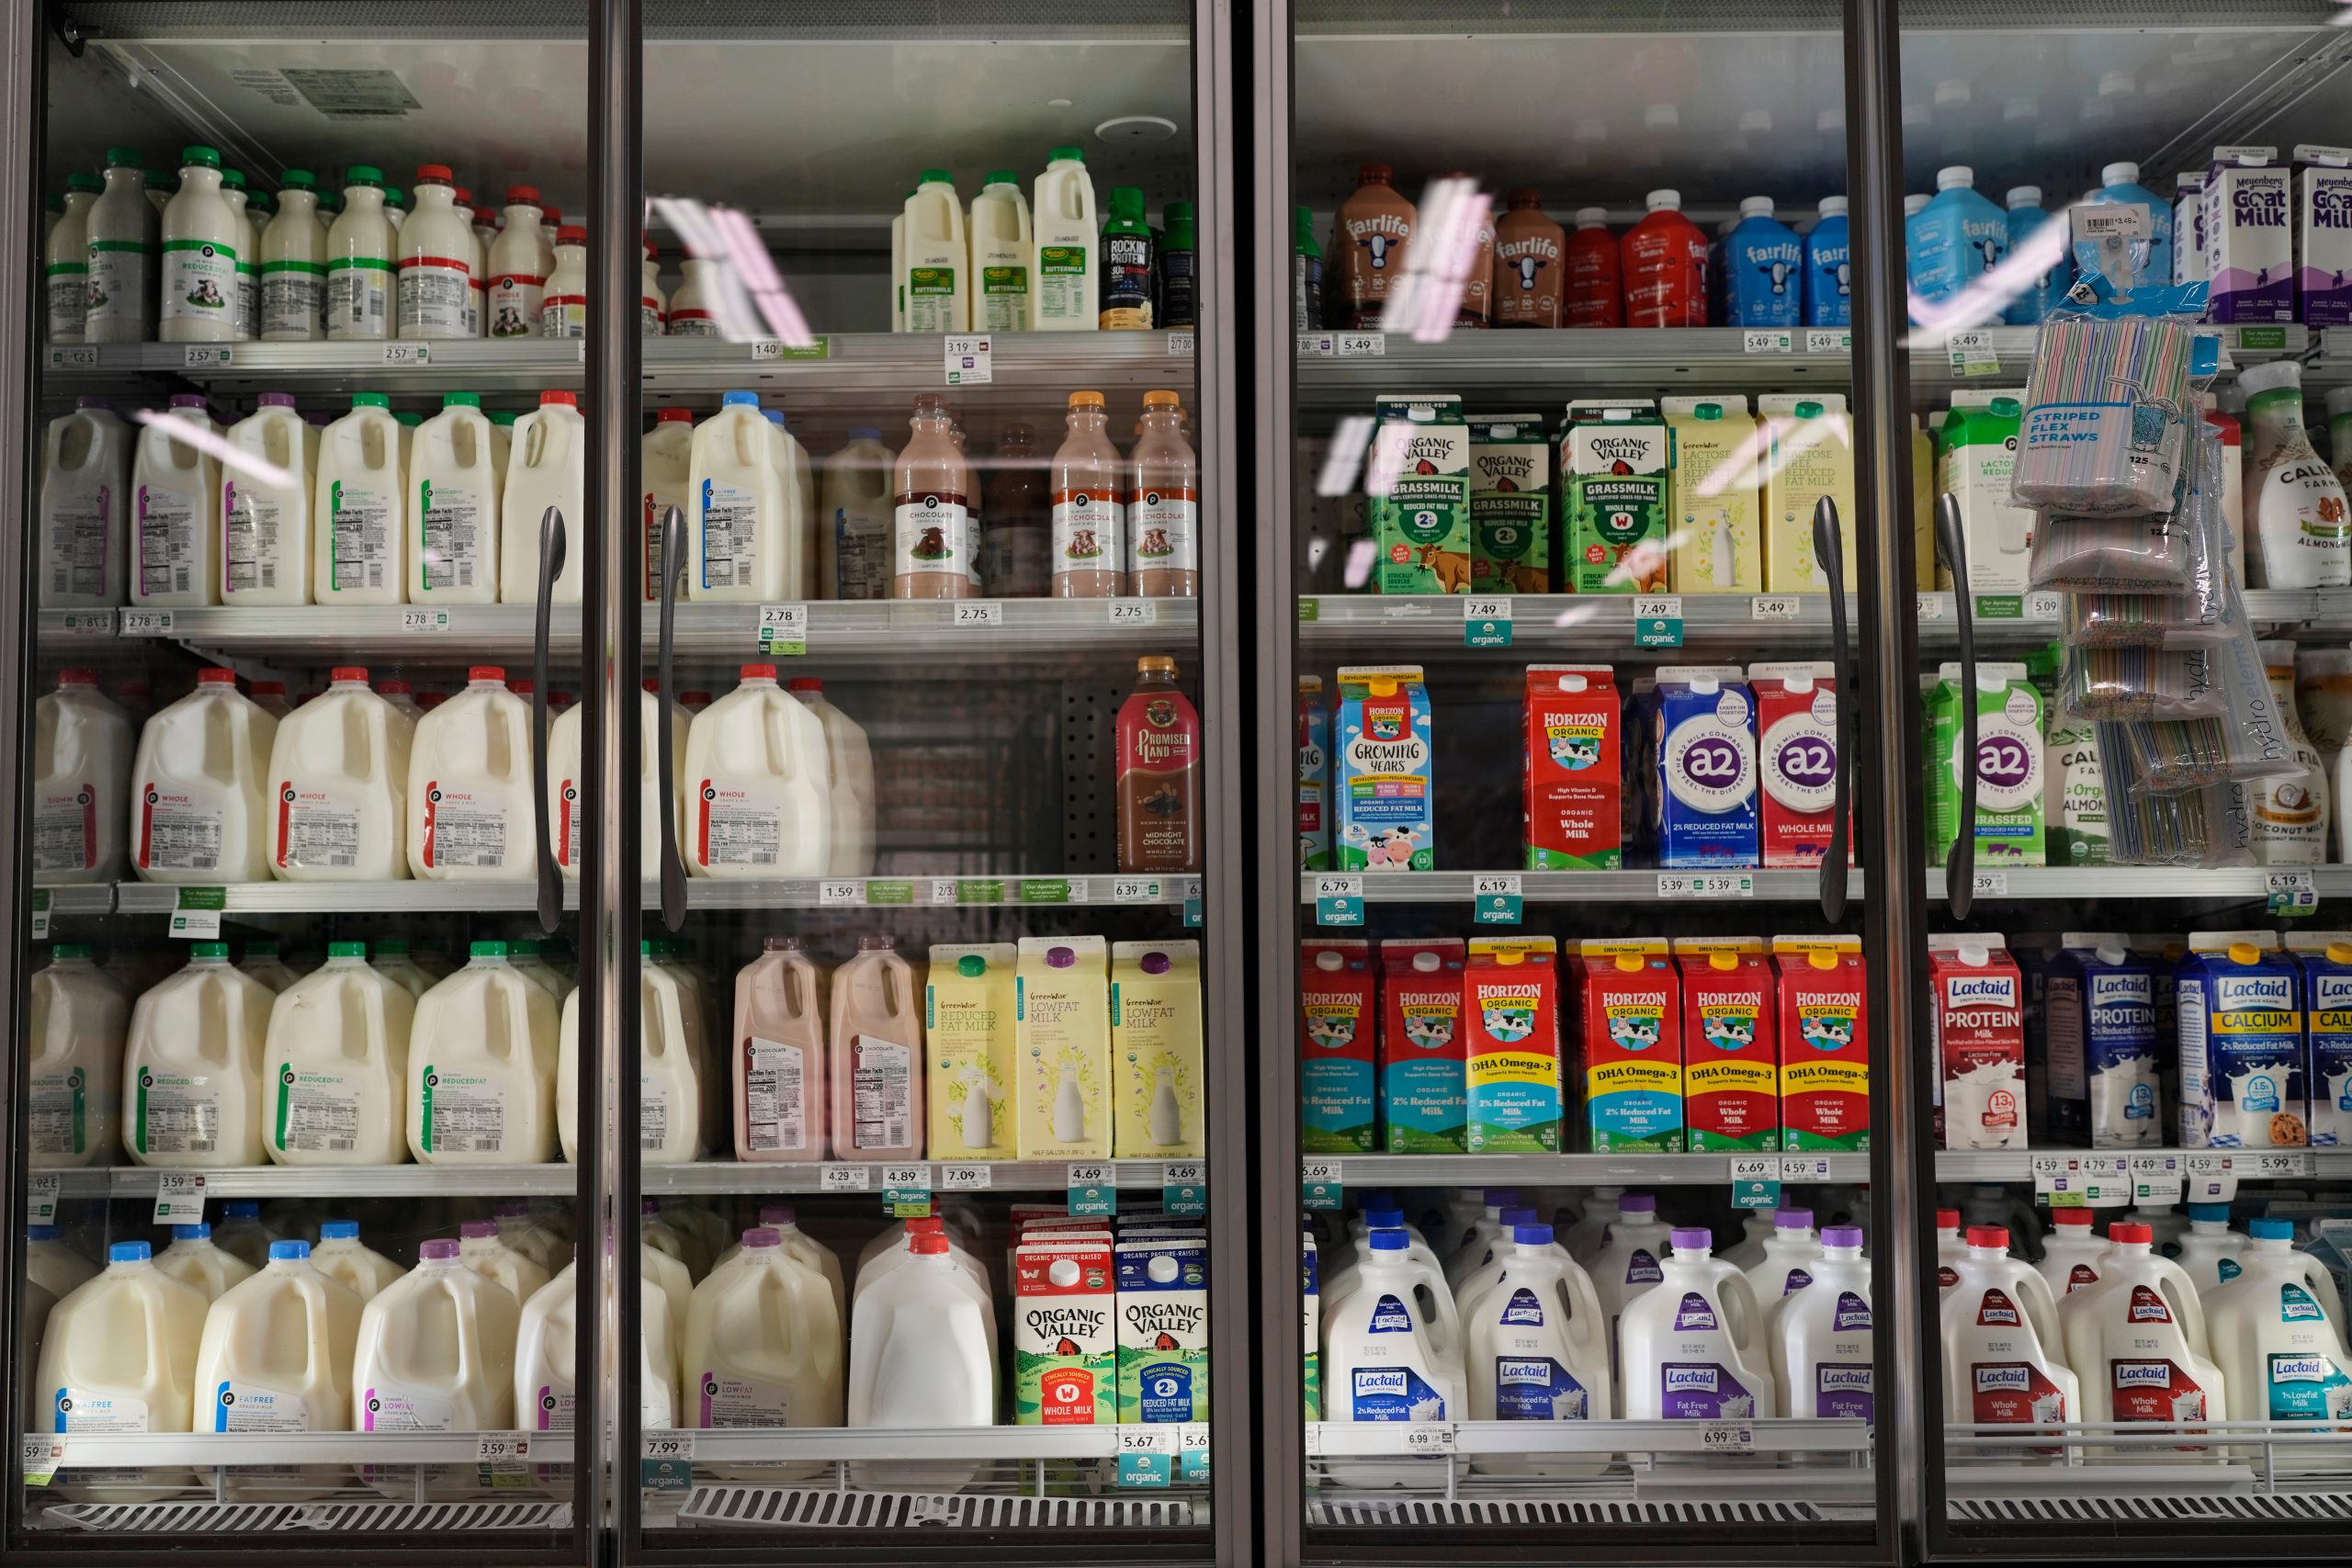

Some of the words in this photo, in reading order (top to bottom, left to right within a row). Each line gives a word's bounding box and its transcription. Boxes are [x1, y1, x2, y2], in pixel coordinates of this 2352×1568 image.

[2236, 175, 2285, 191] Meyenberg
[2232, 189, 2287, 209] Goat
[2234, 208, 2287, 228] Milk
[1111, 253, 1146, 265] PROTEIN
[1045, 265, 1084, 274] BUTTERMILK
[1344, 340, 1372, 350] 5.49
[2032, 412, 2101, 423] STRIPED
[2030, 423, 2070, 434] FLEX
[1590, 437, 1651, 452] ORGANIC
[2029, 433, 2099, 445] STRAWS
[1597, 447, 1645, 461] VALLEY
[1477, 456, 1535, 469] ORGANIC
[2130, 456, 2149, 465] 125
[1483, 465, 1531, 479] VALLEY
[1390, 481, 1463, 495] GRASSMILK
[1586, 482, 1658, 496] GRASSMILK
[1473, 499, 1542, 512] GRASSMILK
[960, 609, 989, 620] 2.75
[1114, 606, 1142, 617] 2.75
[1469, 604, 1497, 615] 7.49
[1639, 604, 1667, 615] 7.49
[1758, 603, 1785, 614] 5.49
[765, 611, 793, 622] 2.78
[1472, 634, 1505, 645] organic
[1642, 633, 1676, 644] organic
[1543, 712, 1609, 728] HORIZON
[1553, 728, 1600, 738] ORGANIC
[1136, 728, 1191, 756] PROMISED
[1143, 743, 1170, 764] LAND
[1354, 742, 1420, 761] GROWING
[1690, 747, 1736, 777] a2
[1784, 745, 1832, 775] a2
[1979, 746, 2025, 776] a2
[1370, 760, 1407, 773] YEARS
[162, 795, 188, 803] WHOLE
[299, 793, 326, 801] WHOLE
[445, 793, 472, 801] WHOLE
[719, 791, 746, 799] WHOLE
[1353, 806, 1389, 814] REDUCED
[1390, 805, 1404, 813] FAT
[1404, 804, 1423, 813] MILK
[1559, 819, 1595, 829] Whole
[1683, 823, 1720, 832] REDUCED
[1720, 823, 1736, 831] FAT
[1735, 822, 1755, 831] MILK
[1145, 831, 1182, 840] MIDNIGHT
[1565, 829, 1590, 840] Milk
[826, 886, 854, 898] 1.59
[1320, 881, 1350, 892] 6.79
[1478, 881, 1508, 892] 6.19
[1324, 911, 1358, 923] organic
[1482, 909, 1516, 921] organic
[1476, 983, 1542, 999] HORIZON
[1951, 979, 2012, 998] Lactaid
[2097, 976, 2148, 995] Lactaid
[2222, 979, 2289, 998] Lactaid
[1399, 992, 1462, 1006] HORIZON
[1486, 999, 1533, 1010] ORGANIC
[1602, 991, 1668, 1007] HORIZON
[1697, 991, 1763, 1007] HORIZON
[1795, 991, 1861, 1007] HORIZON
[1030, 1001, 1080, 1013] LOWFAT
[1125, 1007, 1175, 1019] LOWFAT
[1309, 1007, 1354, 1016] ORGANIC
[1408, 1007, 1453, 1016] ORGANIC
[1611, 1007, 1658, 1017] ORGANIC
[1706, 1007, 1753, 1017] ORGANIC
[1804, 1007, 1852, 1017] ORGANIC
[940, 1010, 997, 1021] REDUCED
[1030, 1011, 1062, 1023] MILK
[1945, 1011, 2020, 1029] PROTEIN
[2090, 1008, 2155, 1025] PROTEIN
[2222, 1012, 2293, 1029] CALCIUM
[940, 1021, 963, 1032] FAT
[964, 1021, 996, 1032] MILK
[1125, 1017, 1158, 1029] MILK
[1471, 1060, 1498, 1073] DHA
[1498, 1057, 1553, 1072] Omega-3
[1596, 1067, 1624, 1081] DHA
[1625, 1066, 1679, 1081] Omega-3
[1690, 1067, 1719, 1081] DHA
[1720, 1066, 1773, 1081] Omega-3
[1736, 1162, 1766, 1173] 6.69
[2261, 1158, 2290, 1169] 5.99
[828, 1171, 850, 1182] 4.29
[888, 1171, 916, 1182] 4.89
[947, 1170, 976, 1181] 7.09
[1072, 1168, 1102, 1179] 4.69
[1168, 1168, 1197, 1179] 4.69
[900, 1192, 927, 1201] organic
[1303, 1197, 1336, 1208] organic
[1740, 1194, 1774, 1206] organic
[1076, 1201, 1109, 1213] organic
[1170, 1201, 1204, 1213] organic
[1026, 1307, 1106, 1326] ORGANIC
[1125, 1303, 1204, 1323] ORGANIC
[1034, 1322, 1101, 1340] VALLEY
[1133, 1318, 1198, 1336] VALLEY
[1502, 1363, 1549, 1380] Lactaid
[2120, 1365, 2166, 1381] Lactaid
[2276, 1360, 2321, 1376] Lactaid
[1358, 1373, 1406, 1390] Lactaid
[1668, 1370, 1715, 1385] Lactaid
[1823, 1370, 1871, 1385] Lactaid
[1979, 1369, 2027, 1384] Lactaid
[721, 1385, 753, 1394] LOWFAT
[239, 1394, 275, 1404] FATFREE
[648, 1442, 679, 1454] 7.99
[1124, 1436, 1154, 1449] 5.67
[649, 1474, 684, 1487] organic
[1125, 1472, 1162, 1484] organic
